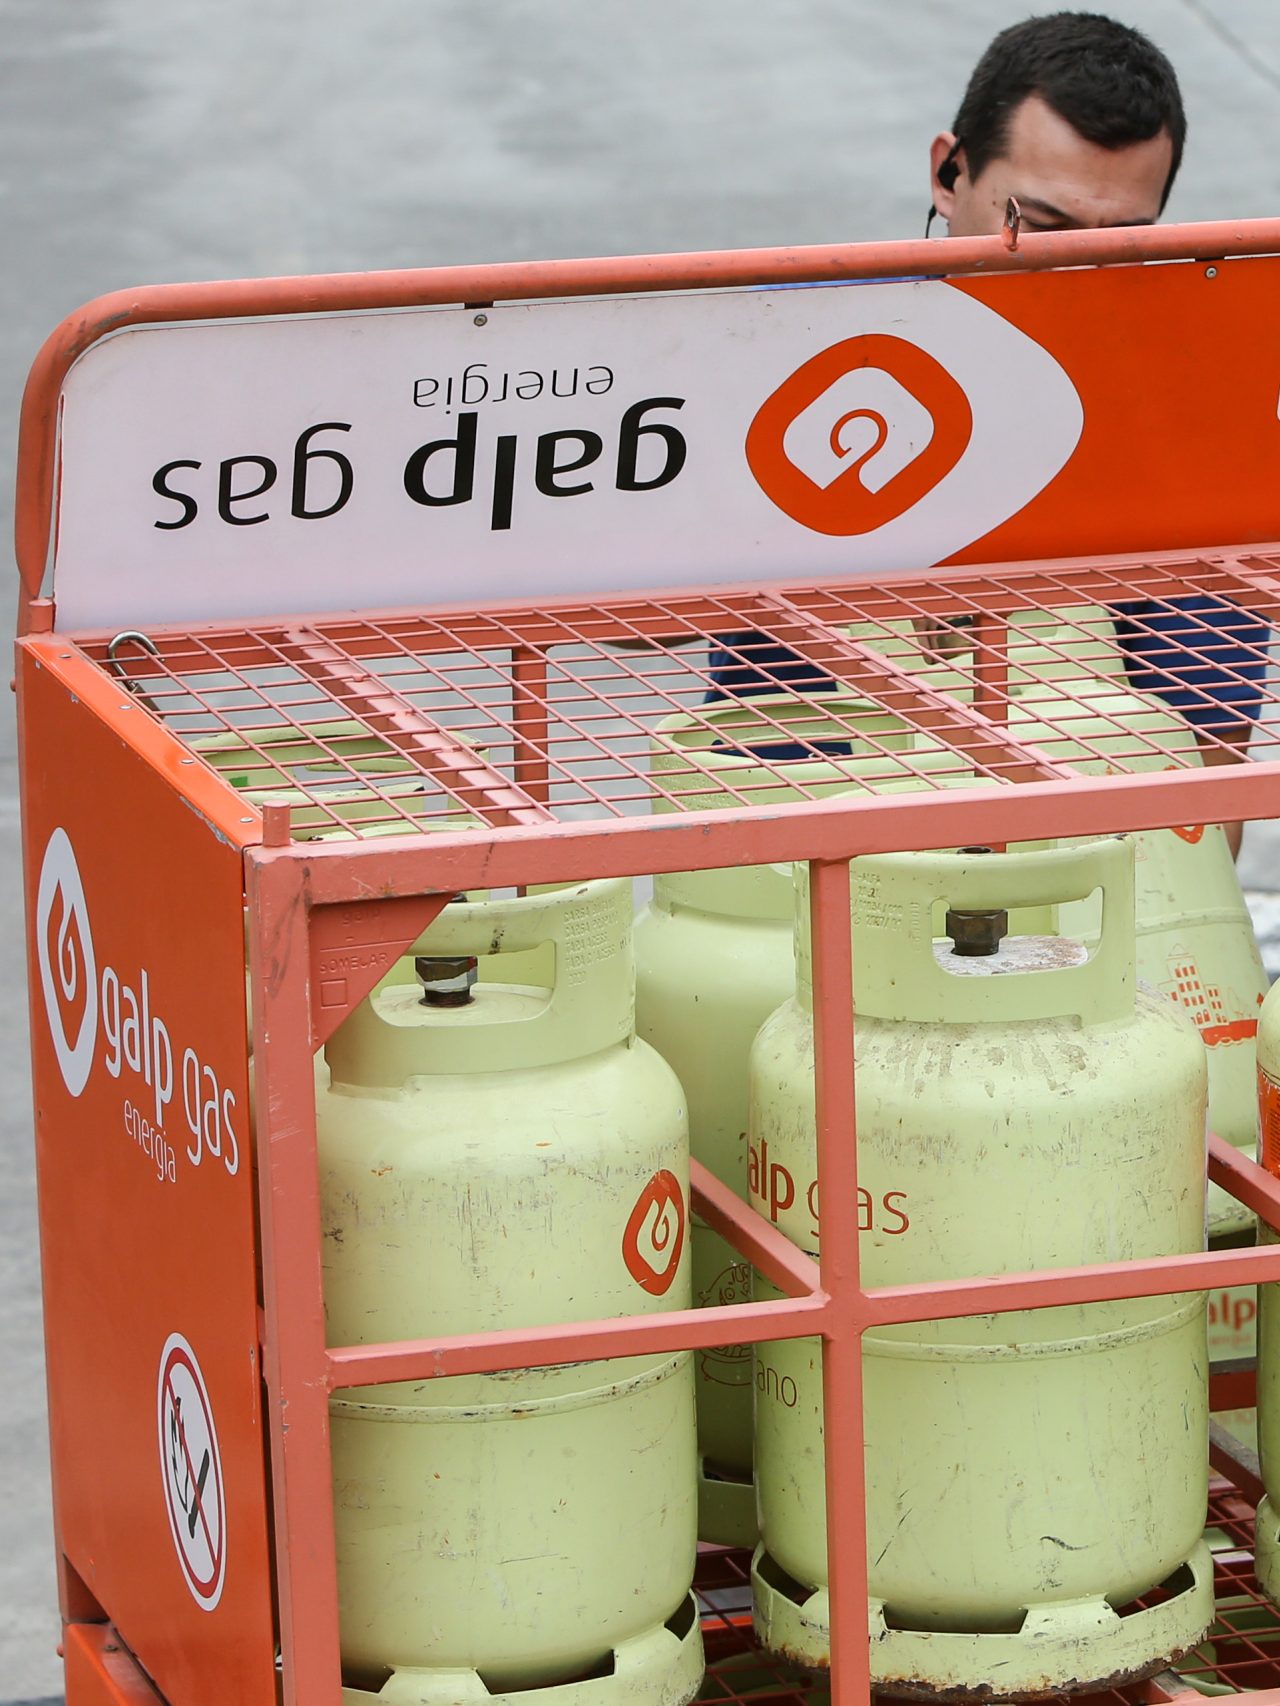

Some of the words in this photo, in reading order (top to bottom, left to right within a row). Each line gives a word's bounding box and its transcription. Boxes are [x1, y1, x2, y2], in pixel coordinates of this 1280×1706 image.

[413, 363, 615, 415] energia
[152, 422, 354, 530] gas
[403, 397, 687, 531] galp
[102, 966, 173, 1127] galp
[183, 1047, 239, 1176] gas
[124, 1098, 177, 1184] energia
[748, 1138, 795, 1223] alp
[756, 1358, 797, 1408] ano
